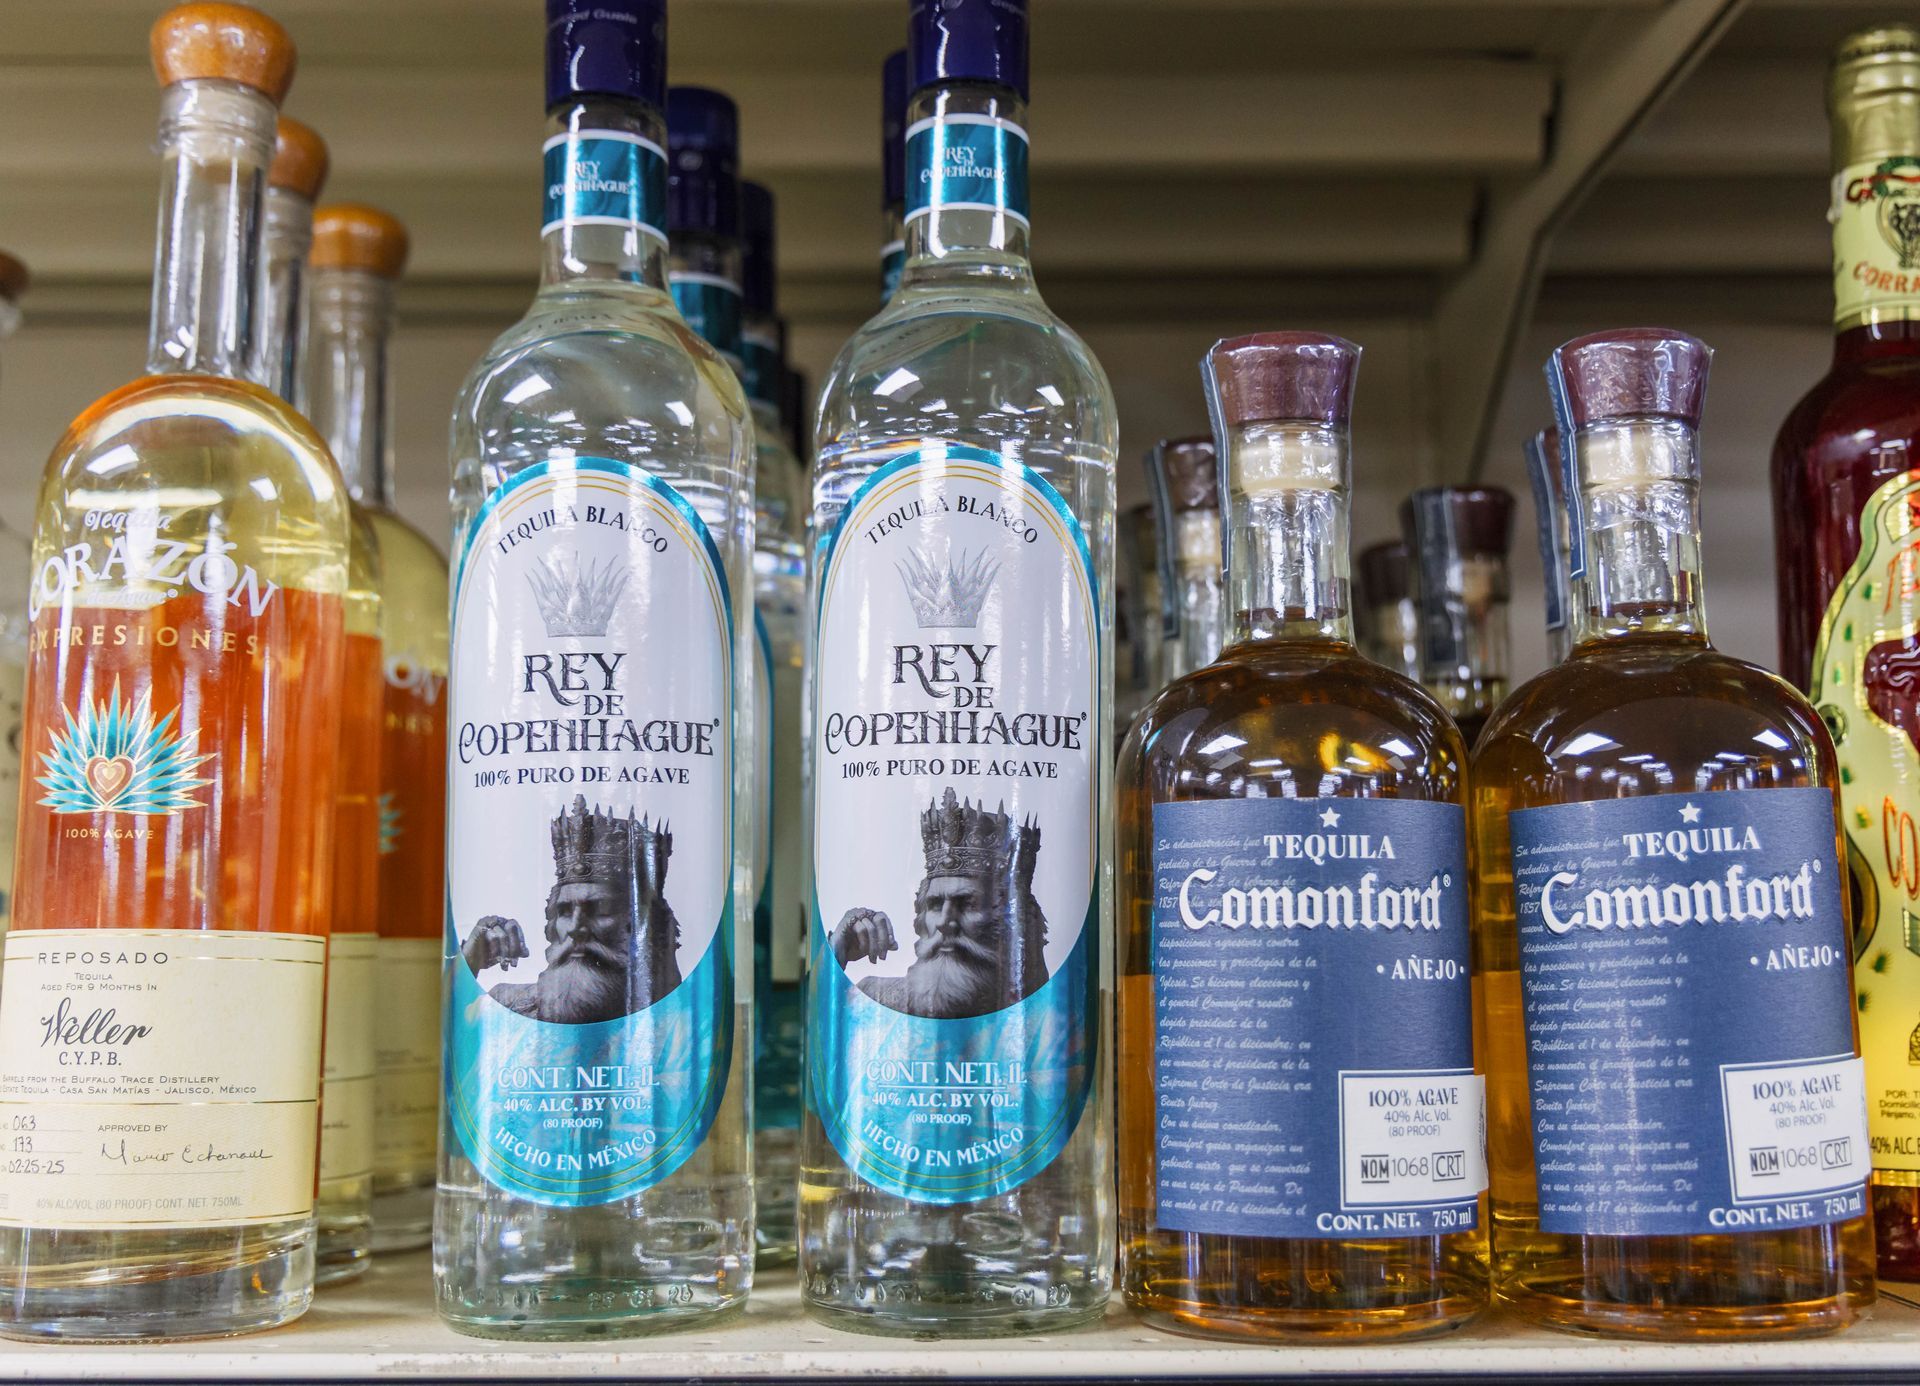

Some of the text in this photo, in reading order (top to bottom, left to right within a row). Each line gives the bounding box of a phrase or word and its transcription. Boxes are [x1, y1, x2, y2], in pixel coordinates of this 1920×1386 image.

[946, 146, 976, 164] REY
[497, 506, 667, 554] TEQUILA BLANCO
[865, 496, 1038, 545] TEQUILA BLANCO
[30, 625, 258, 655] EXPRESIONES
[524, 653, 627, 706] REY
[892, 644, 998, 698] REY
[584, 694, 624, 716] DE
[954, 687, 993, 708] DE
[474, 767, 690, 788] 100% PURO DE AGAVE
[842, 759, 1058, 778] 100% PURO DE AGAVE
[66, 828, 153, 839] 100% AGAVE
[1623, 826, 1761, 862] TEQUILA
[1264, 834, 1396, 865] TEQUILA
[1159, 897, 1178, 909] 1857
[1520, 902, 1540, 914] 1857
[39, 952, 168, 964] REPOSADO
[1392, 954, 1456, 979] AÑEJO
[1766, 944, 1832, 970] AÑEJO
[41, 983, 62, 991] AGED
[66, 983, 83, 991] FOR
[100, 983, 142, 991] MONTHS
[147, 983, 157, 991] IN
[75, 973, 113, 981] TEQUILA
[40, 997, 152, 1047] Weller
[59, 1051, 122, 1066] C.Y.P.B.
[498, 1066, 570, 1089] CONT.
[577, 1066, 634, 1087] NET.
[866, 1061, 939, 1084] CONT.
[945, 1062, 1002, 1084] NET.
[60, 1086, 83, 1094] CASA
[220, 1085, 256, 1093] MÉXICO
[1369, 1088, 1458, 1107] 100% AGAVE
[1752, 1074, 1841, 1100] 100% AGAVE
[504, 1096, 651, 1112] 40% ALC. BY VOL.
[871, 1092, 1019, 1107] 40% ALC. BY VOL.
[1769, 1097, 1836, 1114] 40% Alc. Vol.
[543, 1118, 602, 1129] (80 PROOF)
[911, 1113, 972, 1125] (80 PROOF)
[1384, 1110, 1451, 1122] 40% Alc. Vol.
[1776, 1113, 1826, 1130] (80 PROOF)
[1389, 1125, 1441, 1137] (80 PROOF)
[495, 1127, 656, 1170] HECHO EN MÉXICO
[864, 1120, 1024, 1167] HECHO EN MÉXICO
[1361, 1156, 1462, 1179] NOM 1068 CRT
[1750, 1143, 1849, 1172] NOM 1068 CRT
[1316, 1207, 1472, 1231] CONT. NET. 750 ml
[1709, 1192, 1861, 1227] CONT. NET. 750 ml
